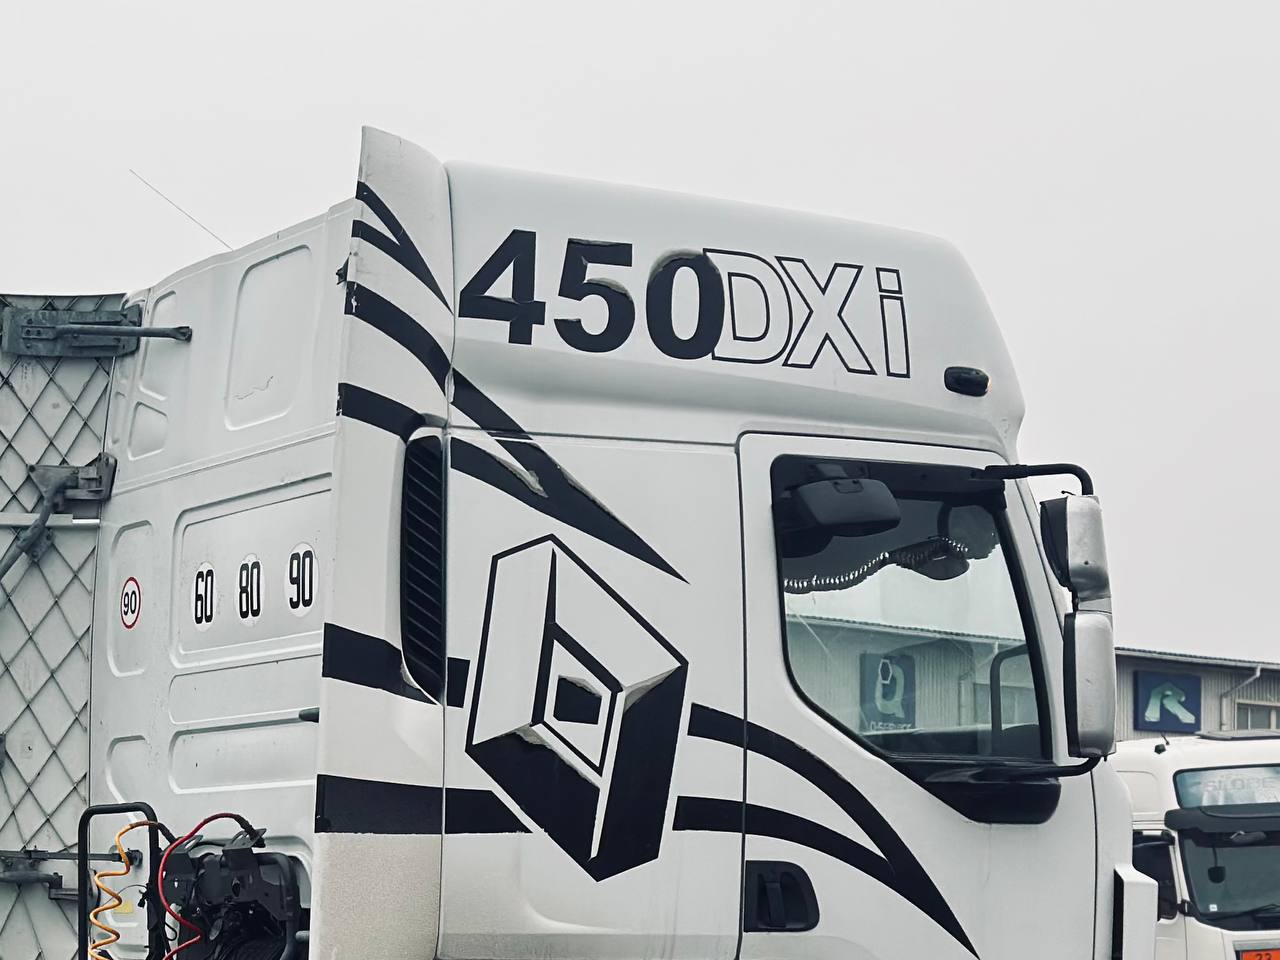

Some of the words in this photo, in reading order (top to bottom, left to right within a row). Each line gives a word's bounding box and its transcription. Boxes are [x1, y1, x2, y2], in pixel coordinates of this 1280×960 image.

[123, 590, 137, 616] 90
[194, 569, 214, 624] 60
[238, 561, 261, 619] 80
[289, 549, 314, 609] 90
